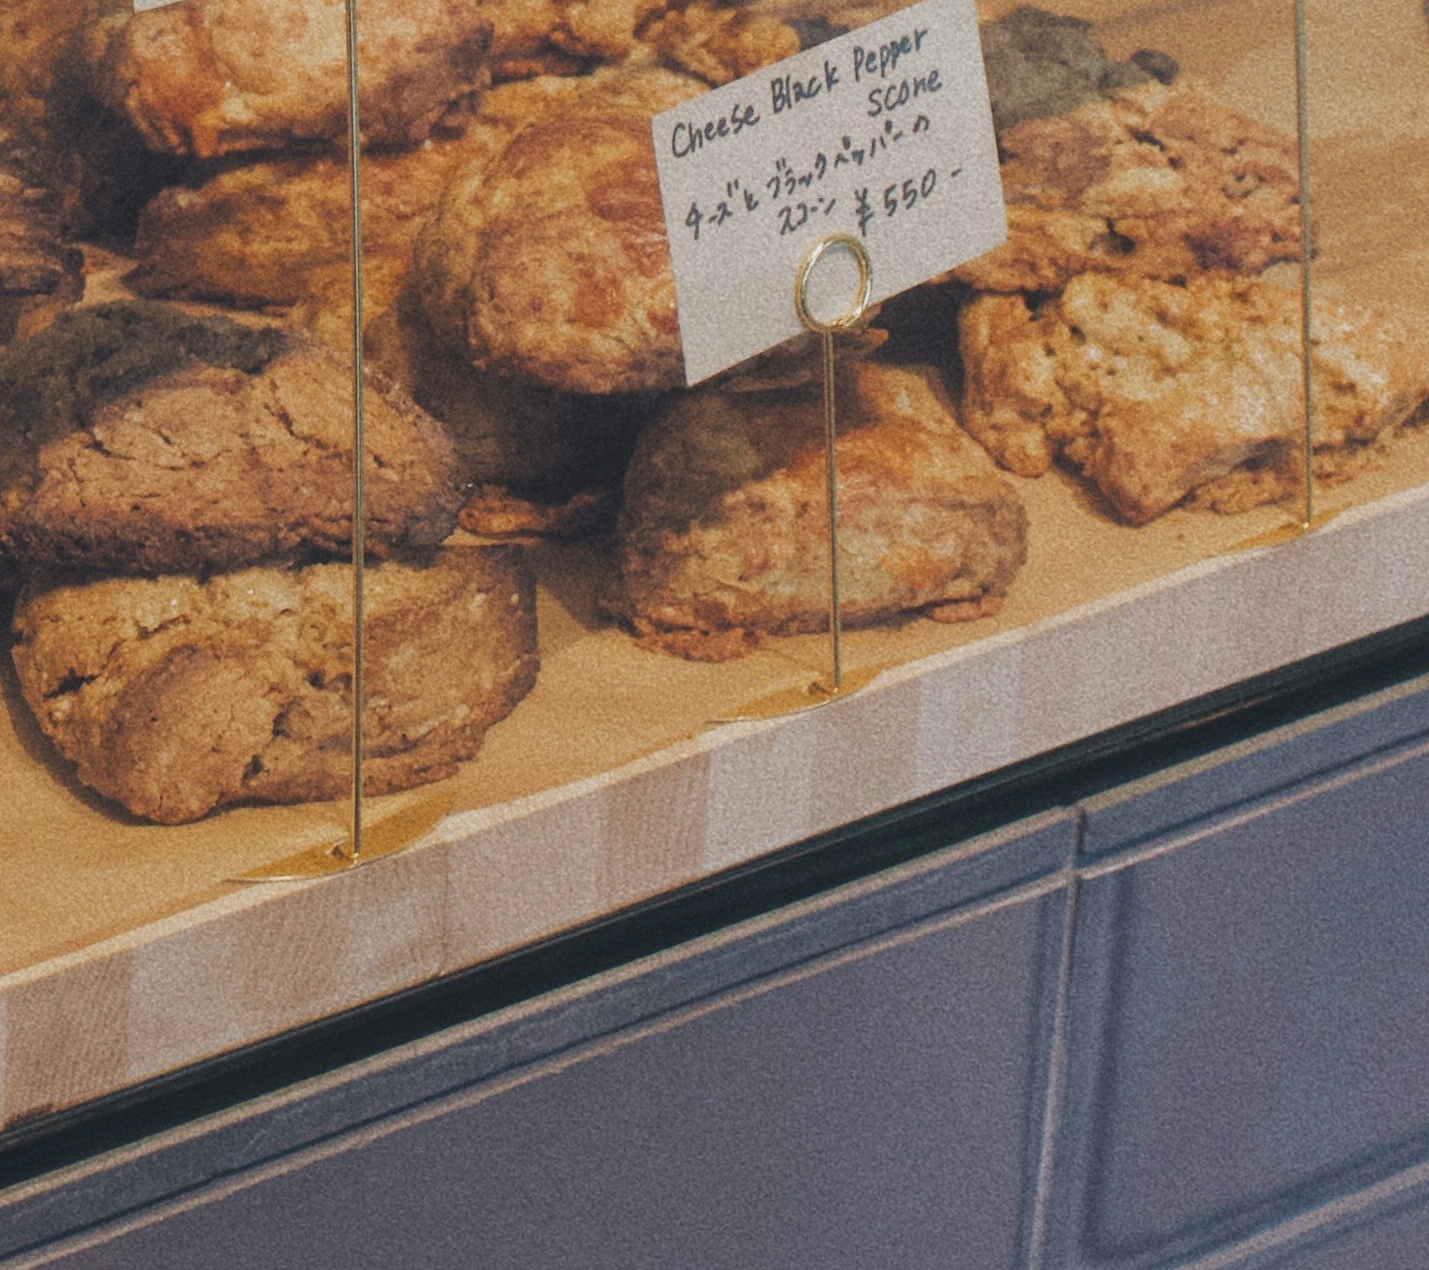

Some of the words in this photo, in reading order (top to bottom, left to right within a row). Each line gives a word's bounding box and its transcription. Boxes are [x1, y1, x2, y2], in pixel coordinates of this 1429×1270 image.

[671, 101, 762, 158] Cheese
[770, 58, 840, 114] Black
[853, 28, 930, 83] Pepper
[777, 197, 838, 237] スコーン
